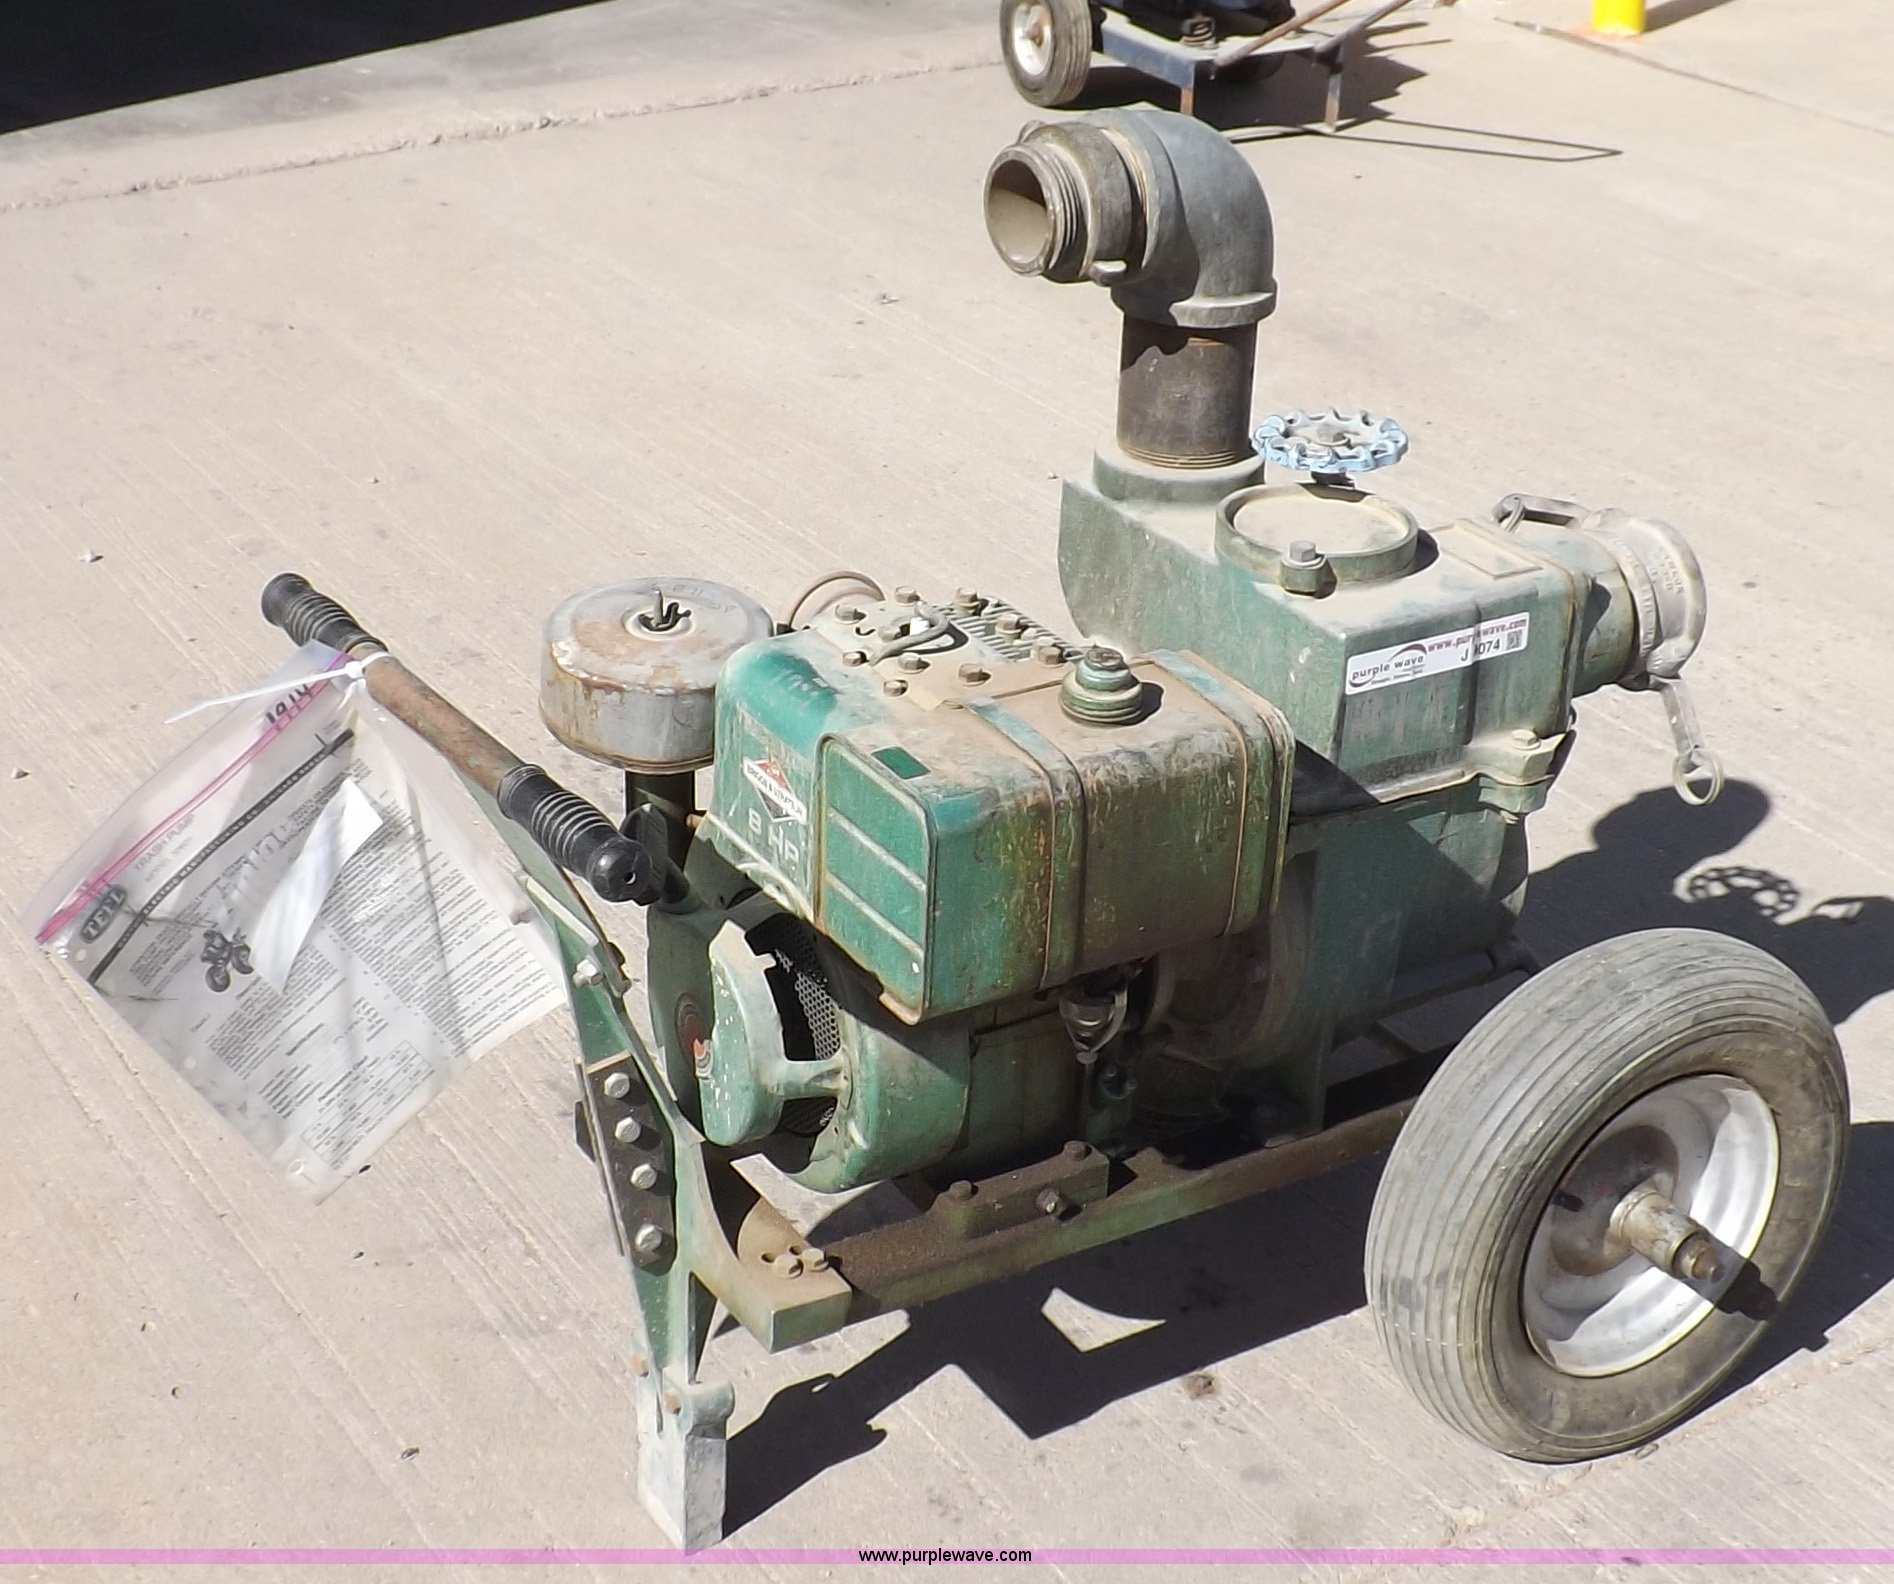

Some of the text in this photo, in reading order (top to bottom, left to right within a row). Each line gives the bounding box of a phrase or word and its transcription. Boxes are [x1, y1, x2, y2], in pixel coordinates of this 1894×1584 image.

[1428, 618, 1527, 652] www.purwave.com
[1352, 663, 1390, 680] purple
[1395, 655, 1424, 668] wave
